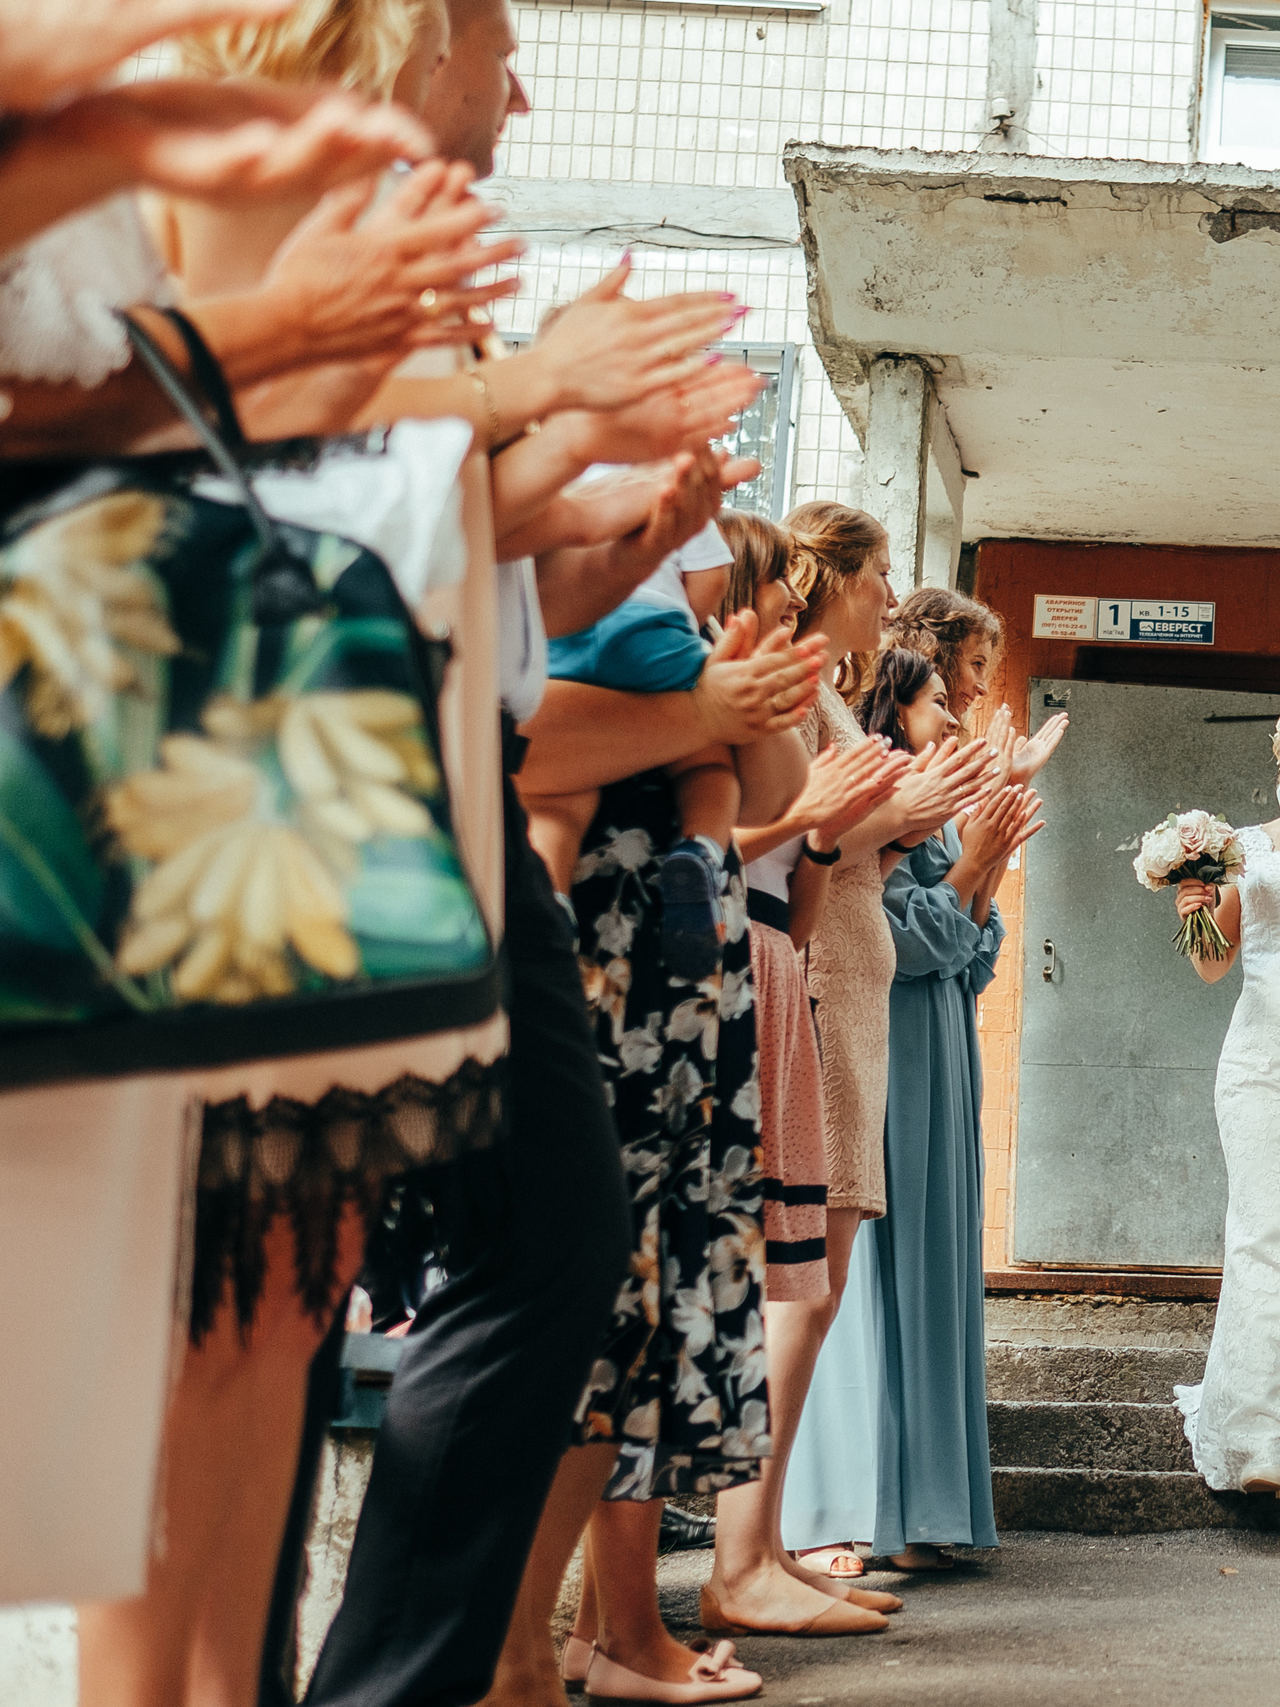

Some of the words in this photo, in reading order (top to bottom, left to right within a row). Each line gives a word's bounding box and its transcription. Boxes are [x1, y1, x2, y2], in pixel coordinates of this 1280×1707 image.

[1109, 604, 1119, 626] 1
[1158, 605, 1190, 618] 1-15
[1155, 623, 1204, 633] ЕВЕРЕСТ
